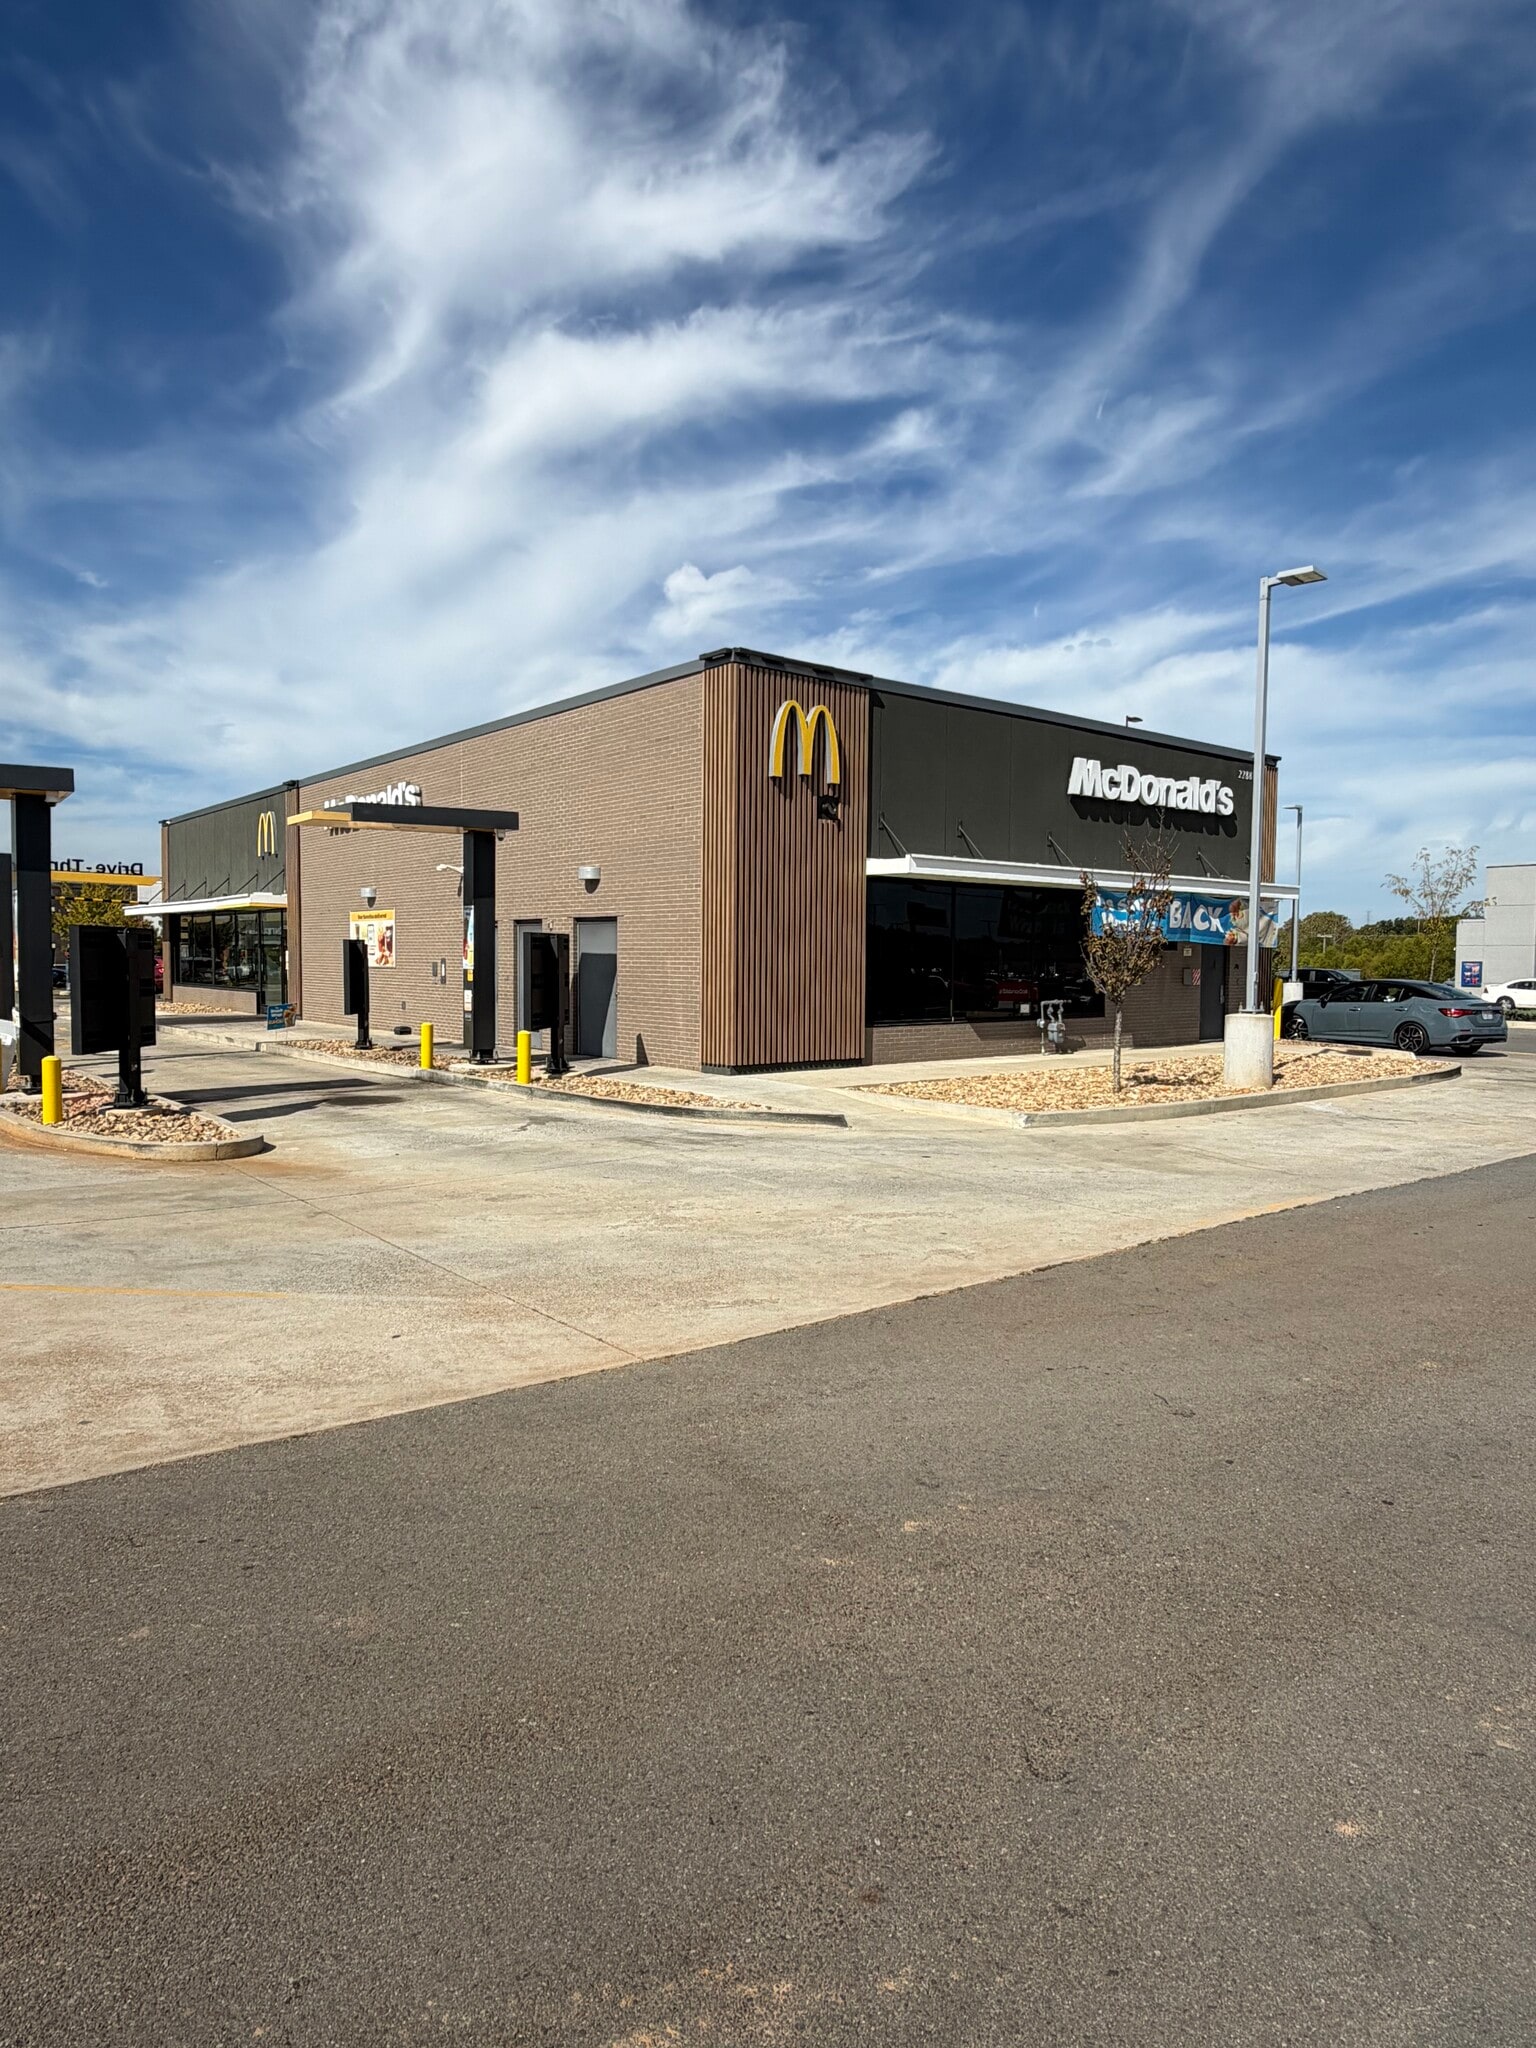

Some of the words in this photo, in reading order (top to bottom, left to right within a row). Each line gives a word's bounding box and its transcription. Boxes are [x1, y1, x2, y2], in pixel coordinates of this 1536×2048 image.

[323, 781, 422, 809] ald's
[1067, 756, 1234, 816] McDonald's
[1168, 900, 1226, 933] BACK
